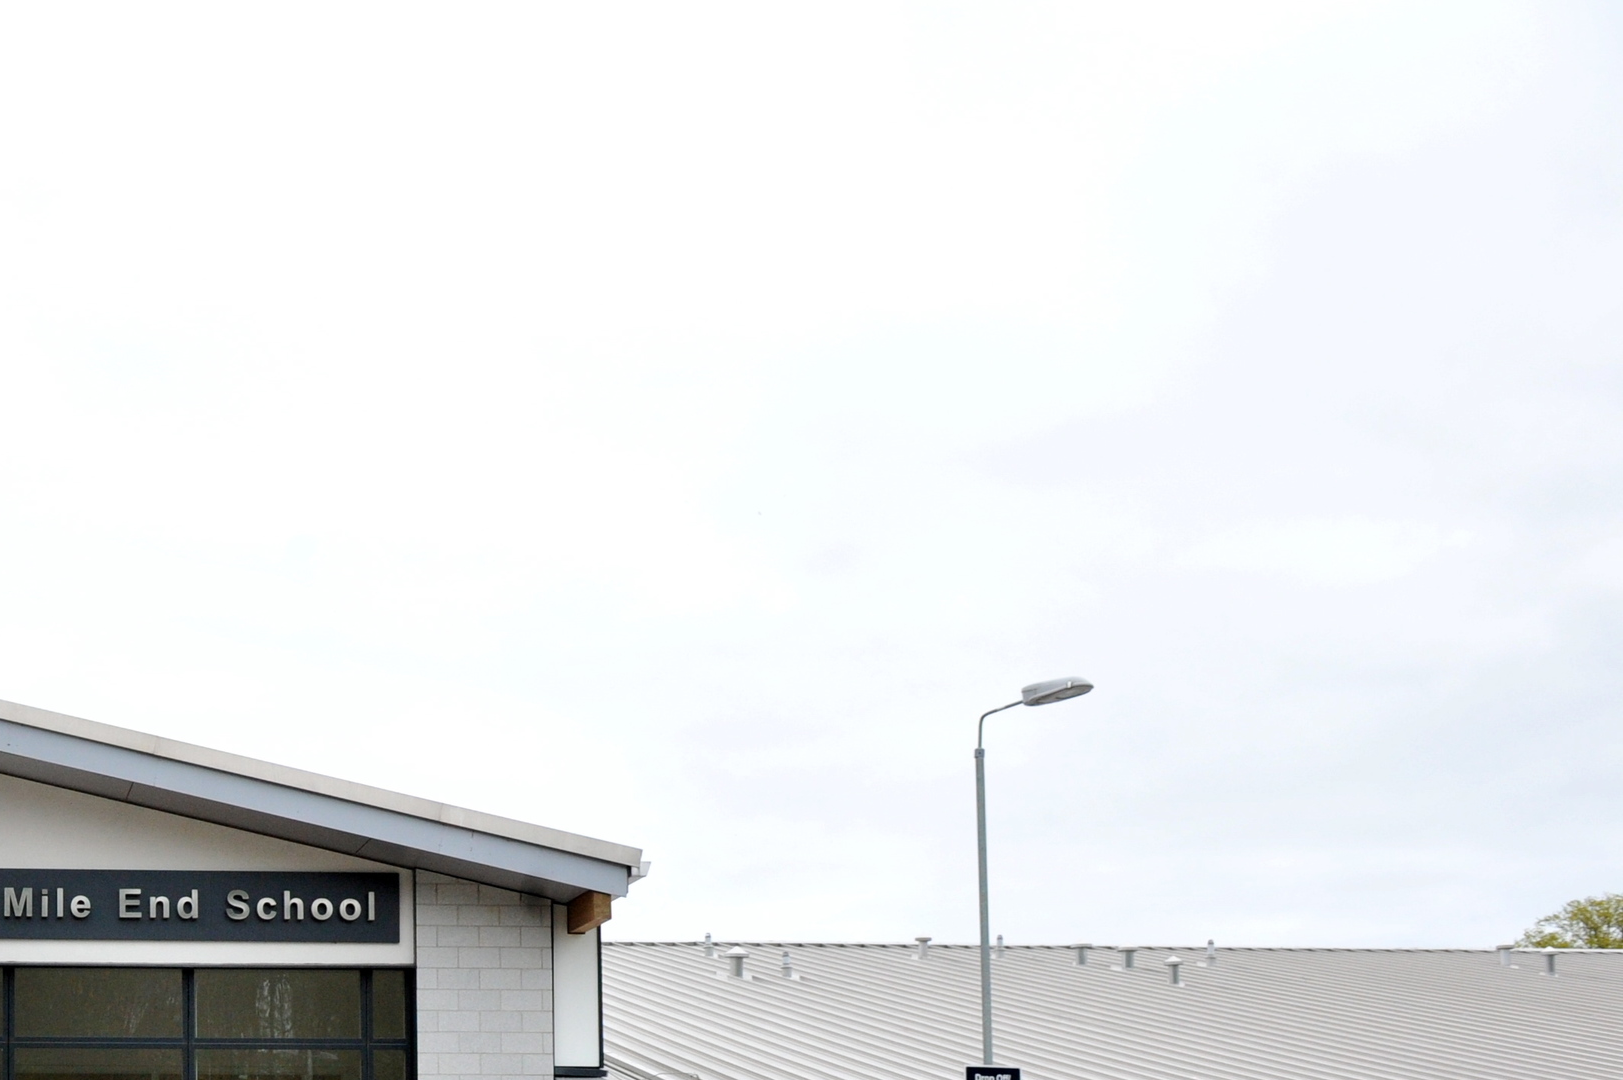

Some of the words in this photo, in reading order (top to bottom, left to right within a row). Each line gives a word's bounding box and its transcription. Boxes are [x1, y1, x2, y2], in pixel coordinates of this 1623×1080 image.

[3, 887, 92, 919] Mile
[119, 888, 200, 920] End
[225, 889, 376, 922] School
